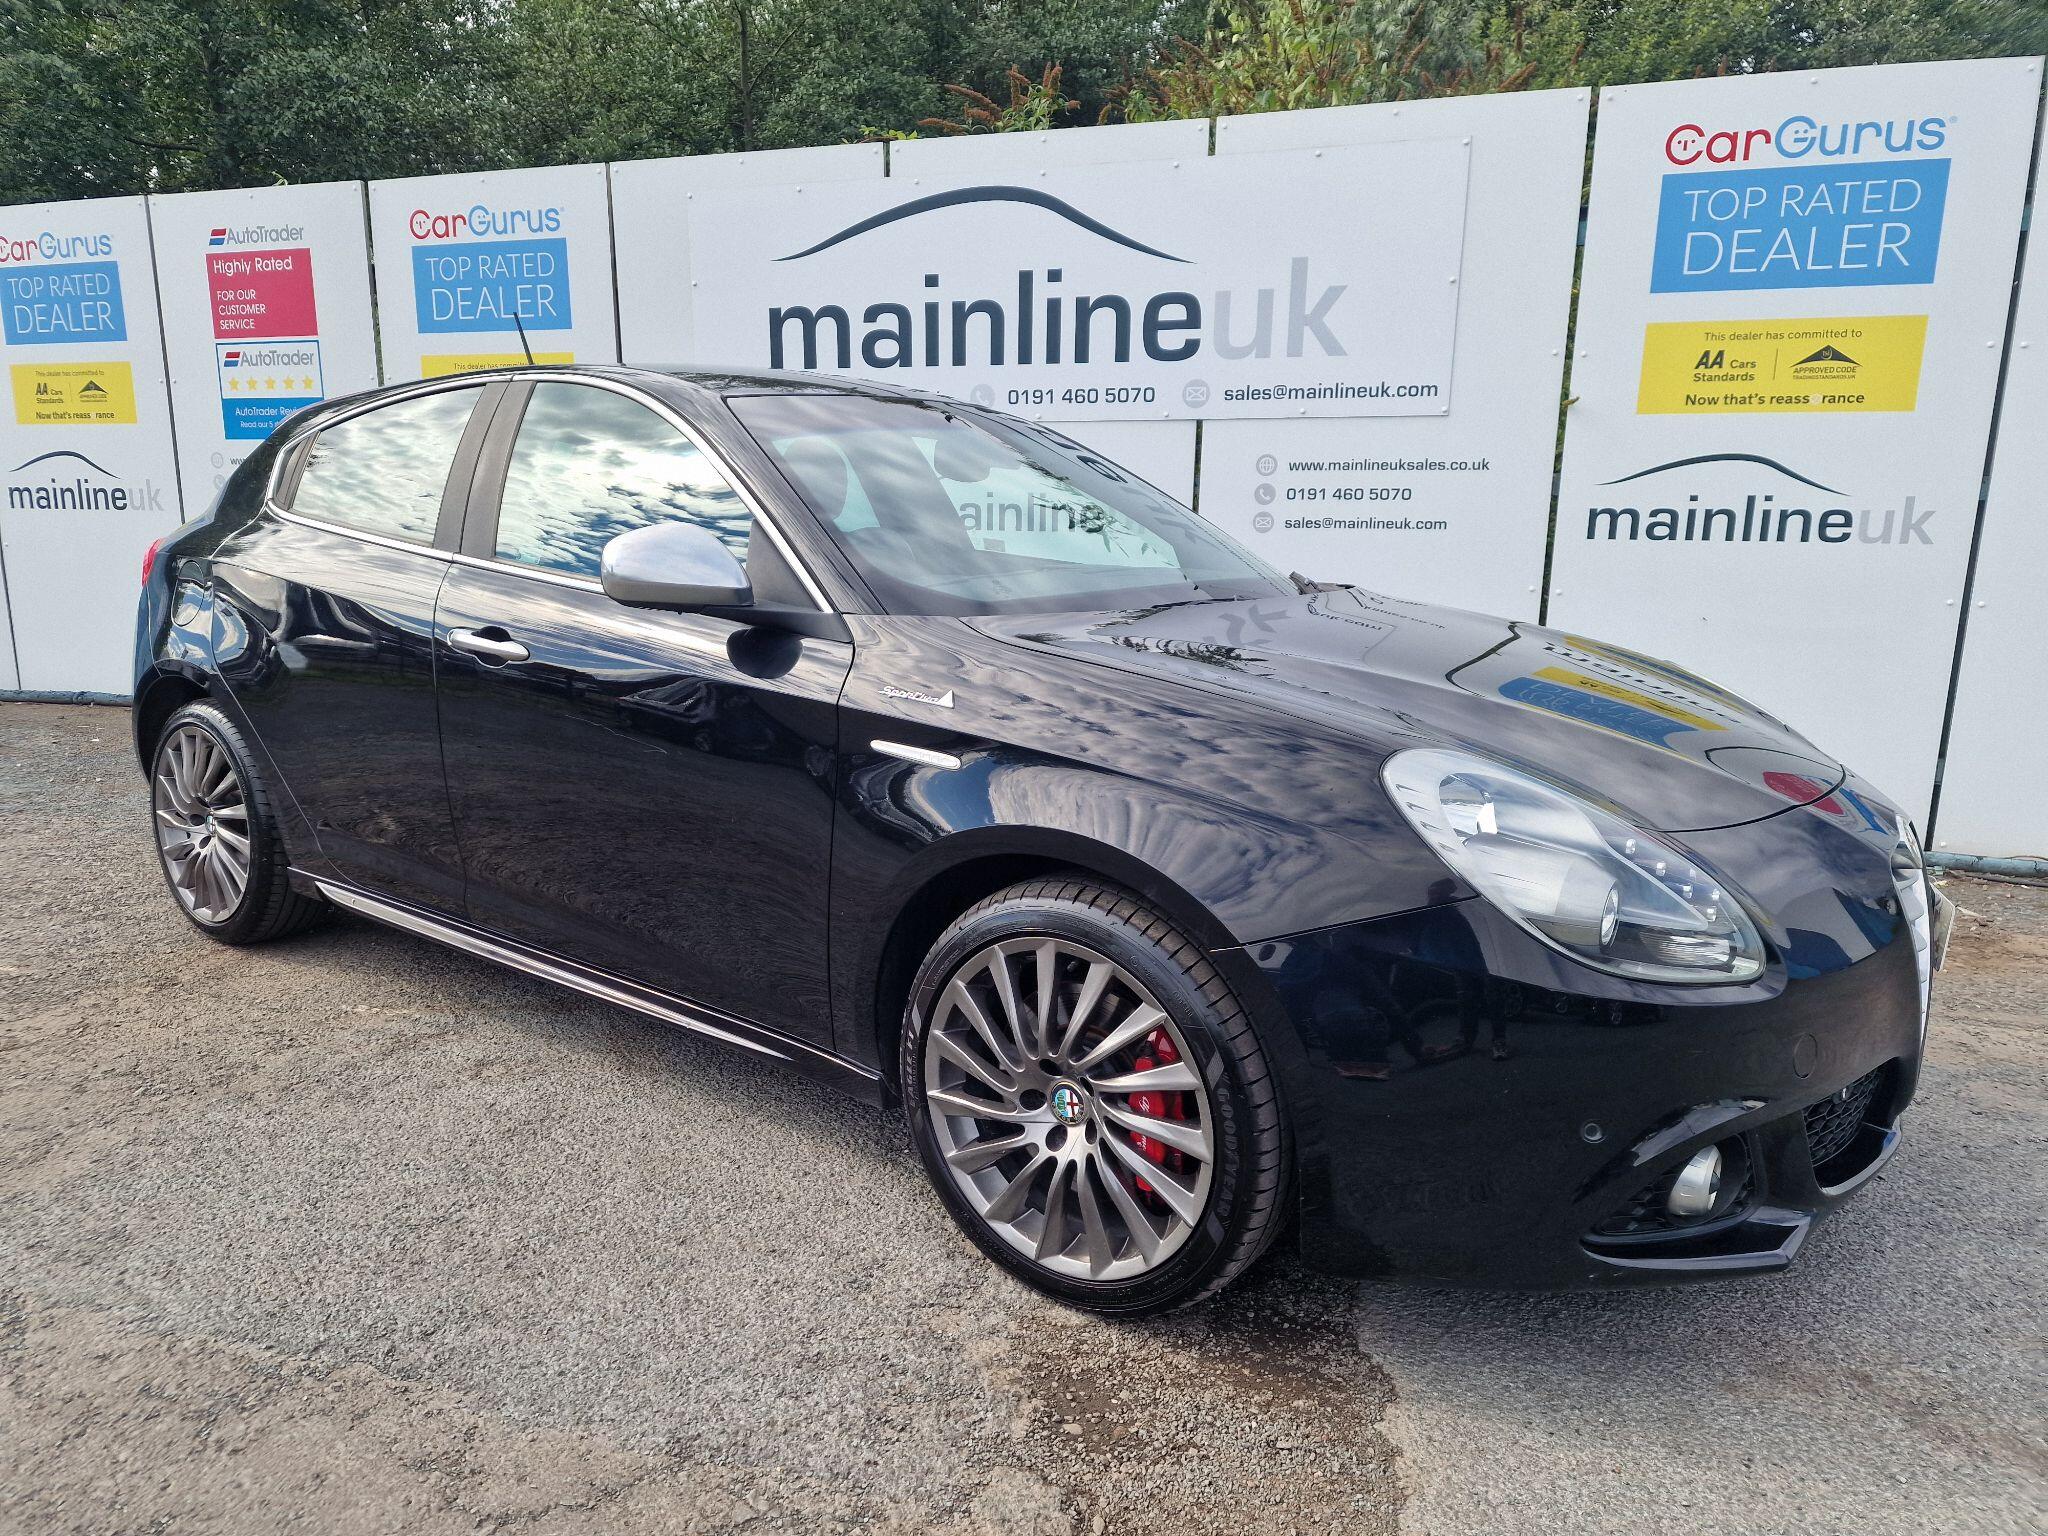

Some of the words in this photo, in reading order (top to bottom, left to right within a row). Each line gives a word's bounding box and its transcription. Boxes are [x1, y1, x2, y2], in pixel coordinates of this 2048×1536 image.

[1665, 115, 1947, 166] CarGurus
[1682, 186, 1767, 222] TOP
[1780, 177, 1922, 217] RATED
[409, 205, 561, 240] CarGurus
[226, 224, 304, 245] AutoTrader
[0, 231, 113, 263] CarGurus
[1682, 222, 1912, 276] DEALER
[213, 258, 252, 277] Highly
[254, 256, 294, 272] Rated
[425, 256, 471, 282] TOP
[479, 252, 555, 280] RATED
[7, 277, 44, 299] TOP
[49, 273, 110, 297] RATED
[217, 290, 235, 301] FOR
[236, 288, 257, 300] OUR
[218, 303, 267, 316] CUSTOMER
[431, 284, 558, 321] DEALER
[769, 256, 1350, 370] mainlineuk
[14, 301, 116, 334] DEALER
[220, 318, 256, 330] SERVICE
[1704, 332, 1726, 341] This
[1729, 331, 1764, 341] dealer
[1766, 330, 1785, 340] has
[1788, 329, 1848, 340] committed
[1851, 328, 1863, 338] to
[240, 349, 314, 367] AutoTrader
[1694, 349, 1726, 370] AA
[1730, 359, 1757, 369] Cars
[1693, 371, 1756, 382] Standards
[1793, 366, 1835, 374] APPROVED
[35, 382, 48, 396] AA
[1007, 387, 1055, 406] 0191
[1061, 387, 1100, 405] 460
[1105, 386, 1156, 404] 5070
[1224, 381, 1440, 402] sales@mainlineuk.com
[1685, 393, 1719, 406] Now
[1723, 392, 1766, 405] that's
[1770, 393, 1865, 405] reassrance
[72, 411, 115, 419] reassrance
[235, 406, 278, 417] AutoTrader
[1288, 458, 1490, 472] www.mainlineuksales.co.uk
[8, 477, 164, 511] mainlineuk
[1286, 488, 1327, 501] 0191
[1332, 488, 1364, 501] 460
[1369, 488, 1412, 501] 5070
[1284, 517, 1448, 531] sales@mainlineuk.com
[1586, 493, 1937, 546] mainlineuk
